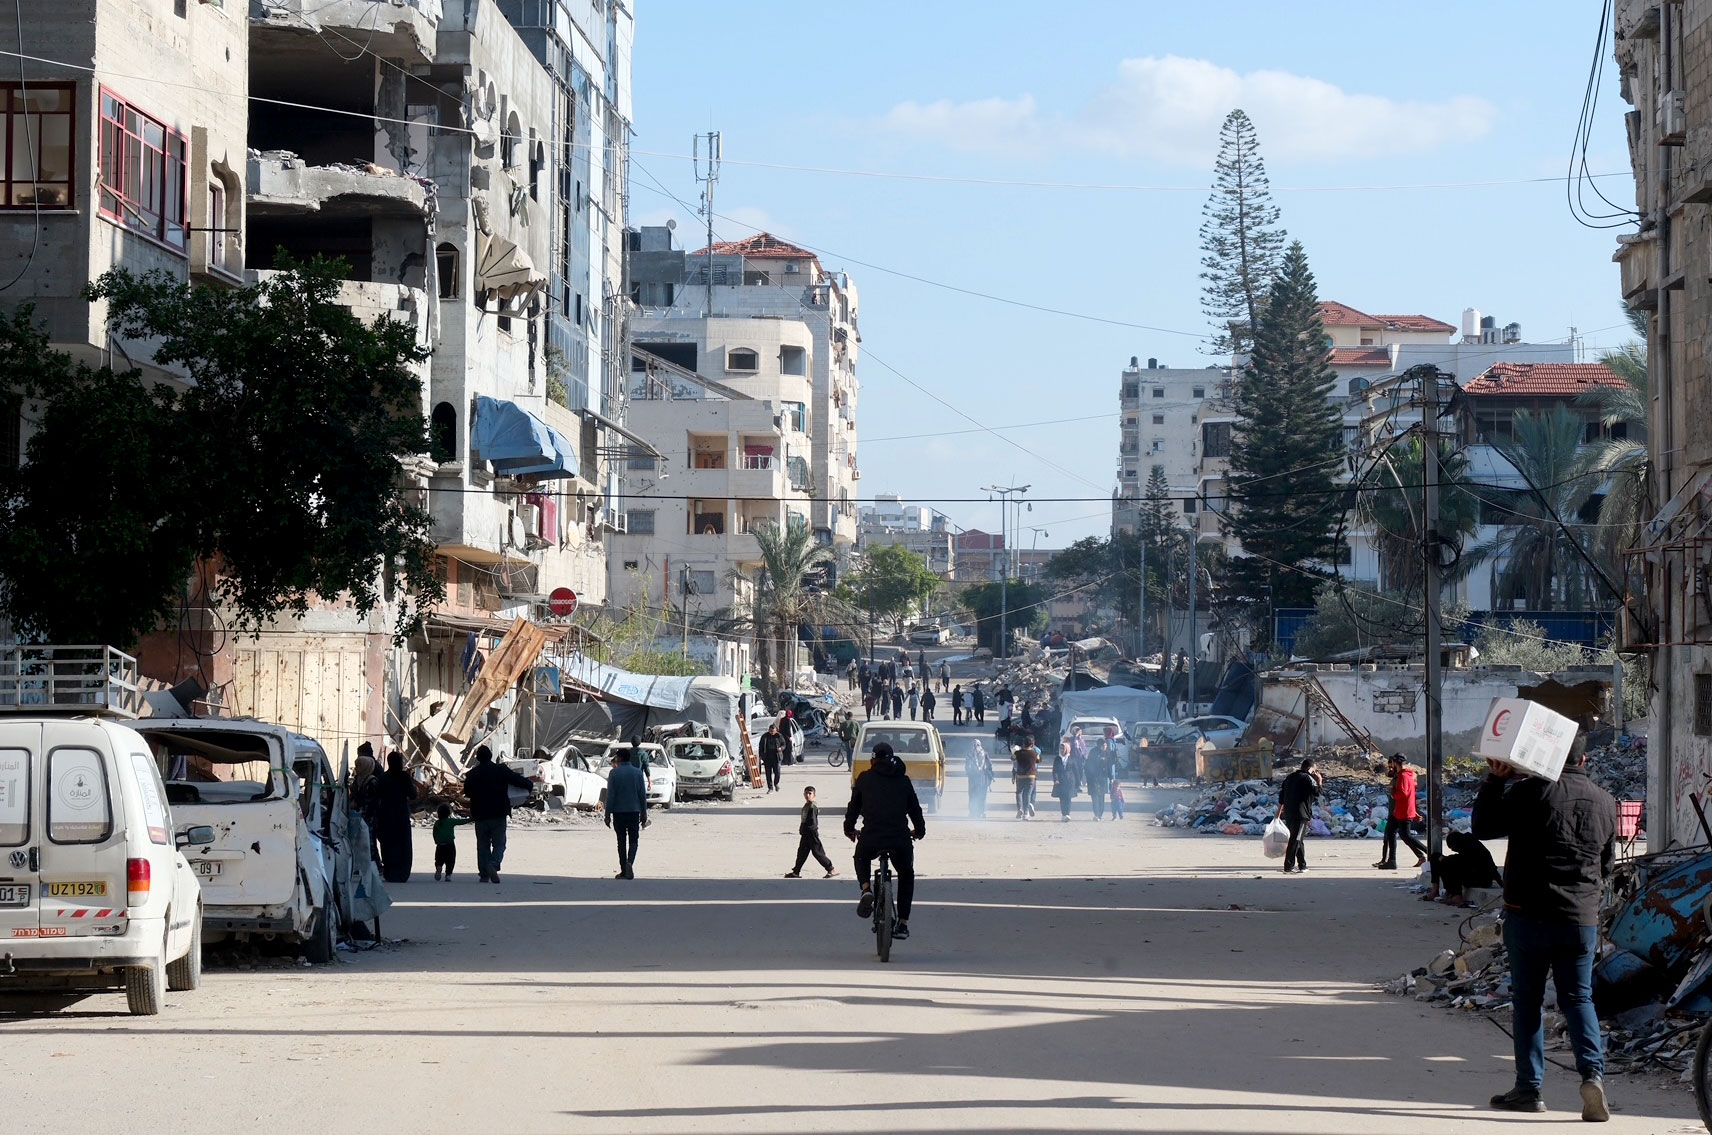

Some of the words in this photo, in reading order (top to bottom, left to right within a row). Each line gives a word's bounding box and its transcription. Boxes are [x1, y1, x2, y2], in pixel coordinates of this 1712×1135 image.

[0, 760, 20, 771] المنار
[69, 788, 91, 798] المنارة
[51, 883, 94, 896] UZ192
[12, 928, 38, 936] מרחק
[41, 927, 65, 935] שמור
